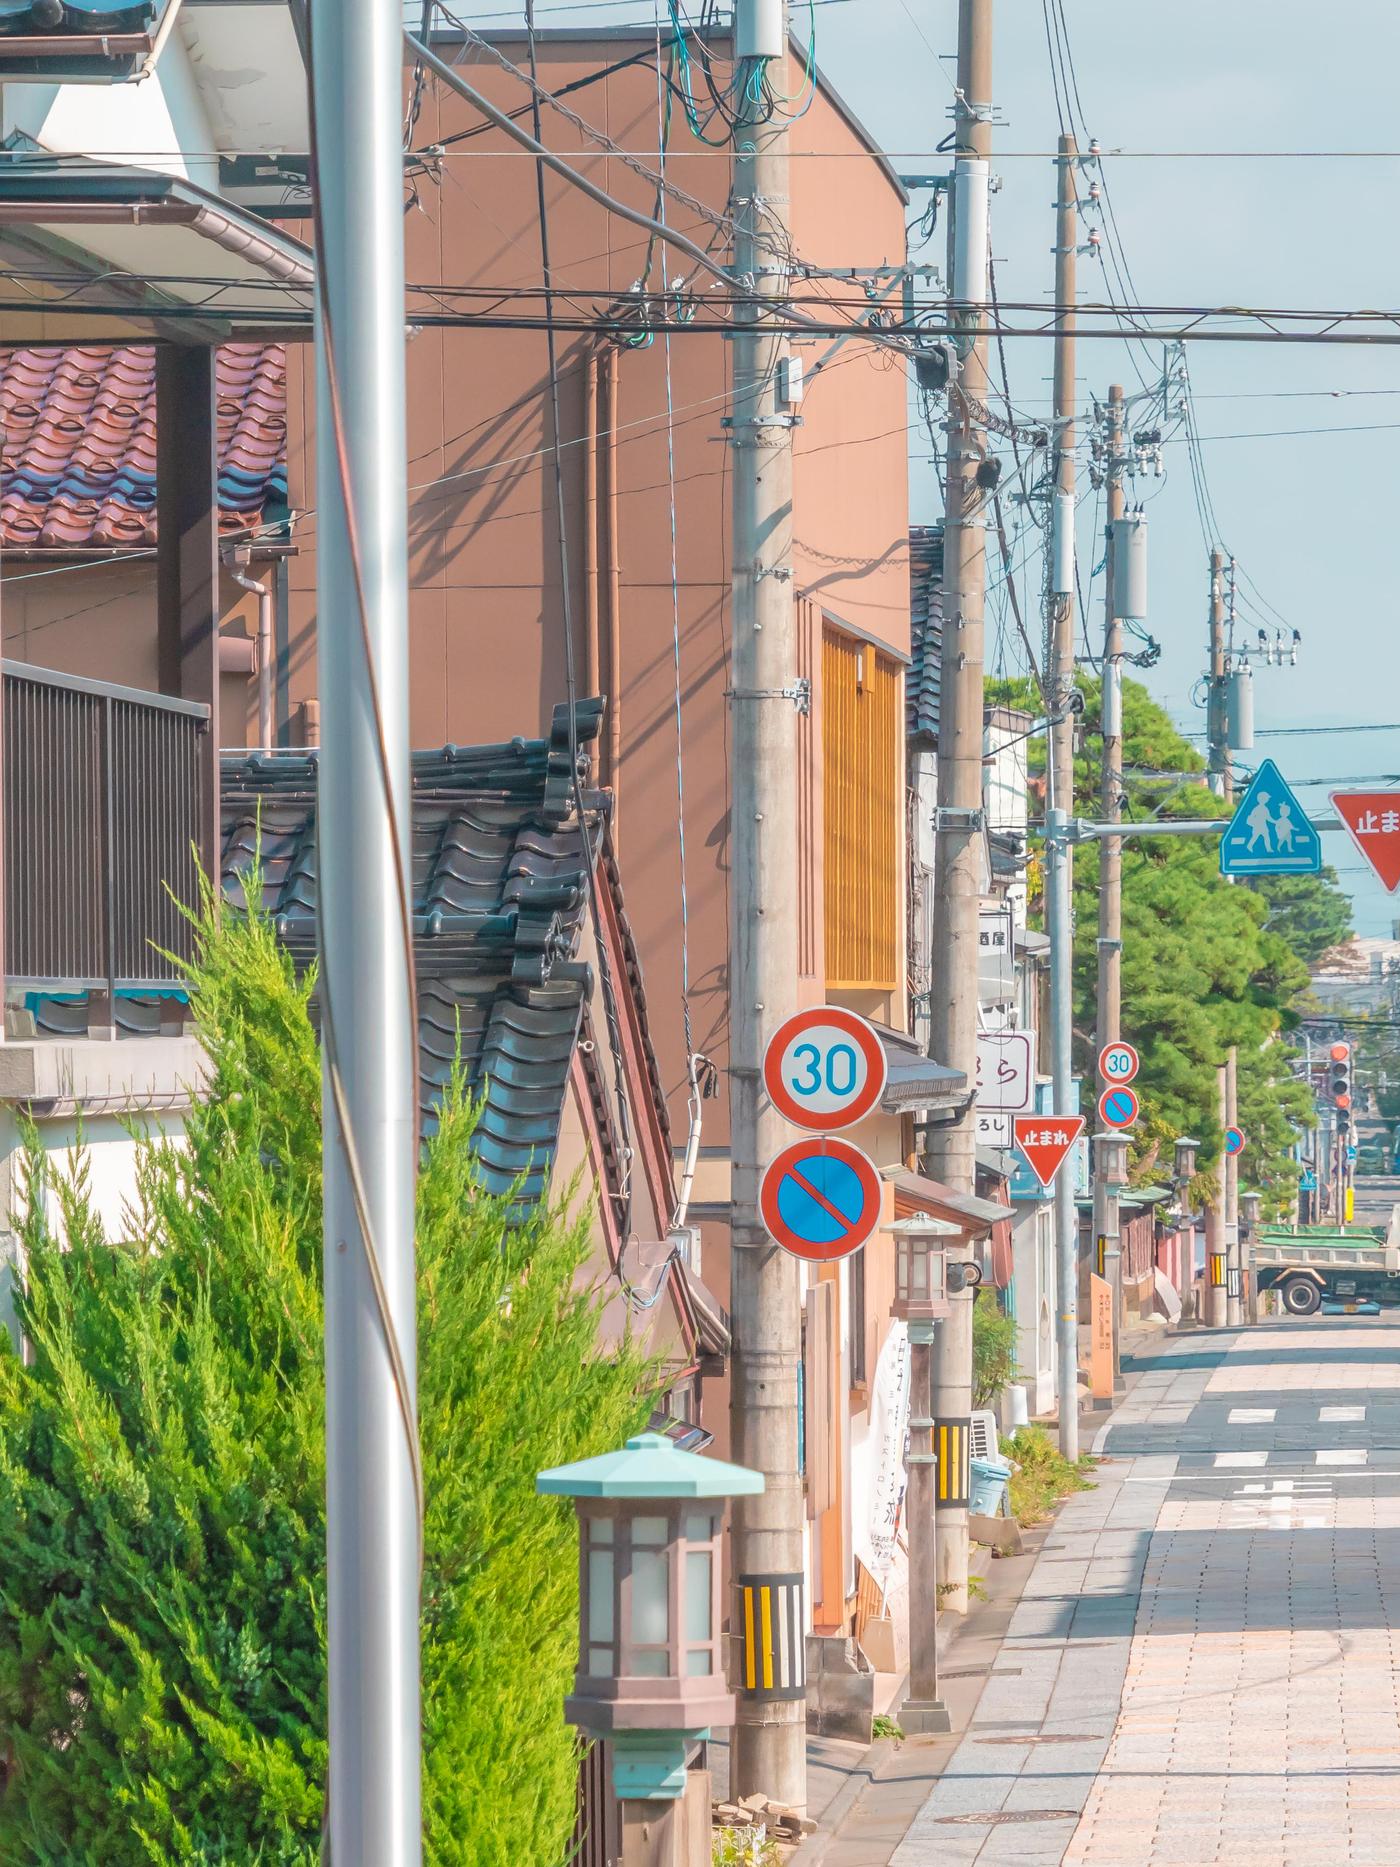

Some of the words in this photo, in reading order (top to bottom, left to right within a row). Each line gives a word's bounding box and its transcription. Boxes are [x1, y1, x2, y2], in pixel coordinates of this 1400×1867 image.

[791, 1043, 857, 1096] 30
[1107, 1054, 1130, 1073] 30
[1023, 1129, 1070, 1147] 止まれ
